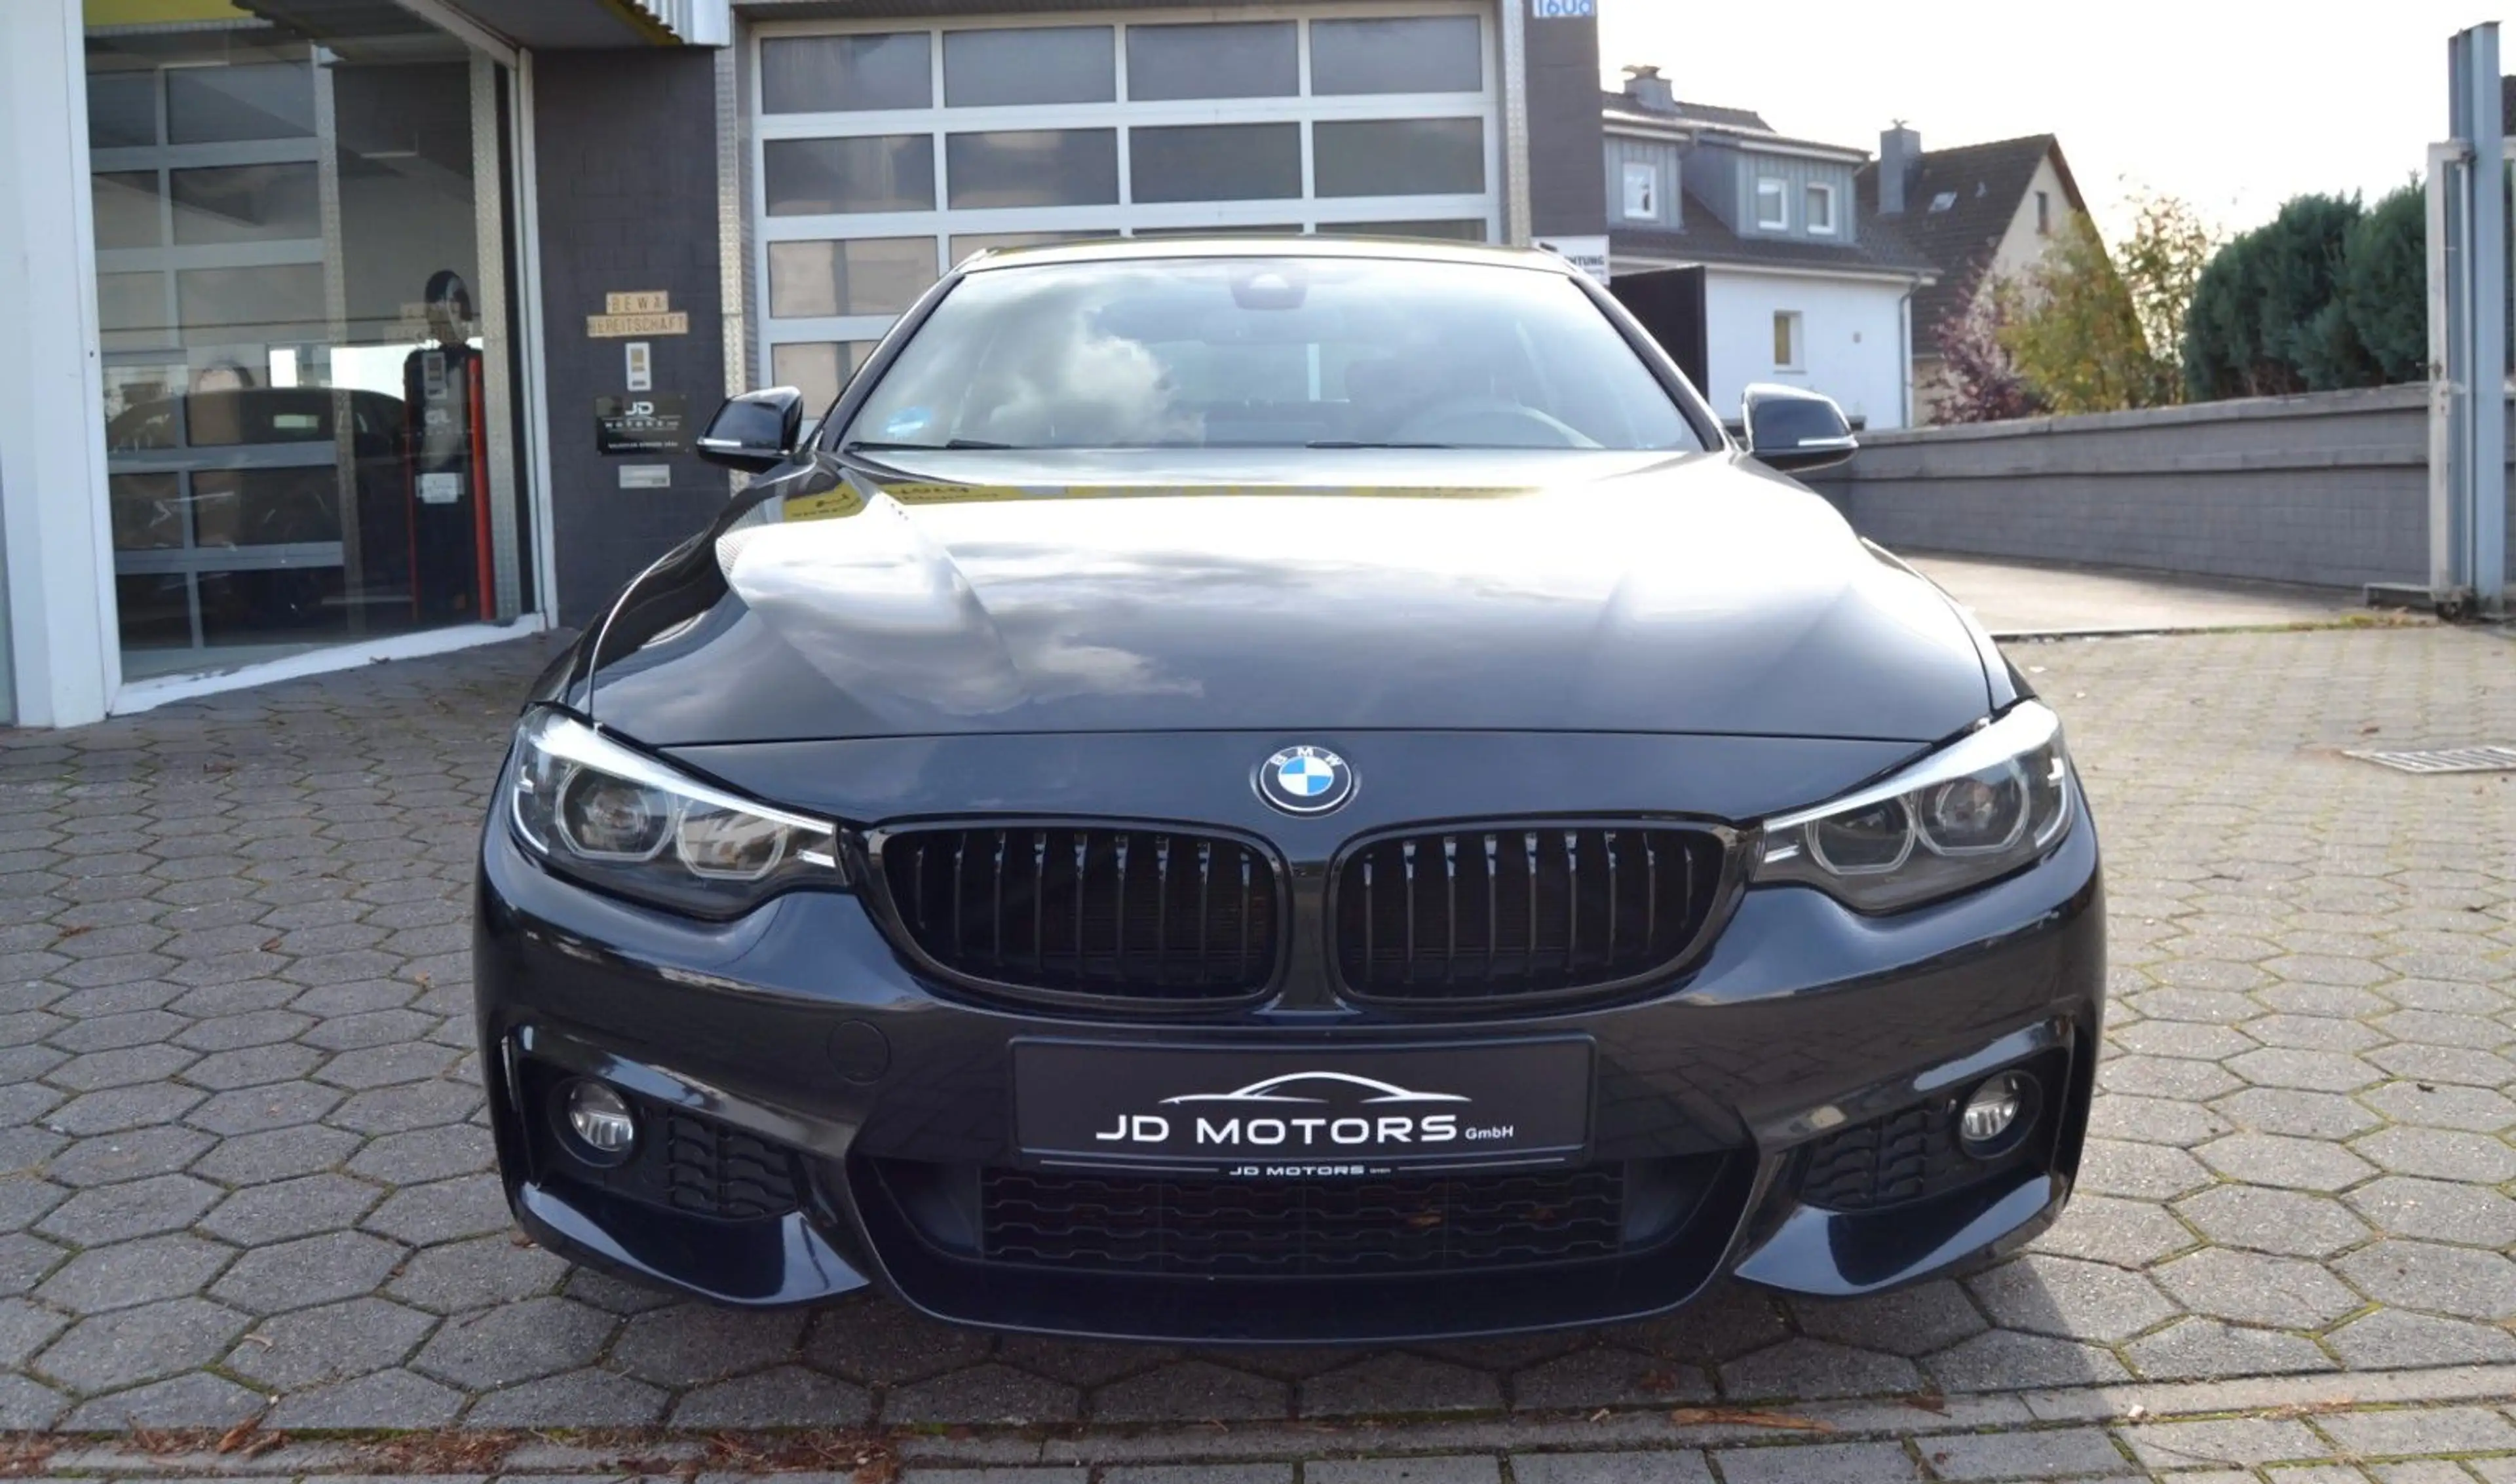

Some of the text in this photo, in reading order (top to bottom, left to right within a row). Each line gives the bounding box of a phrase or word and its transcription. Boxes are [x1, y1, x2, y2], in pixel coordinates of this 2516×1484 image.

[624, 401, 655, 415] JD
[1269, 746, 1343, 767] BMW
[1096, 1114, 1514, 1145] JD MOTORS GmbH
[1229, 1166, 1260, 1176] JD
[1267, 1166, 1365, 1176] MOTORS
